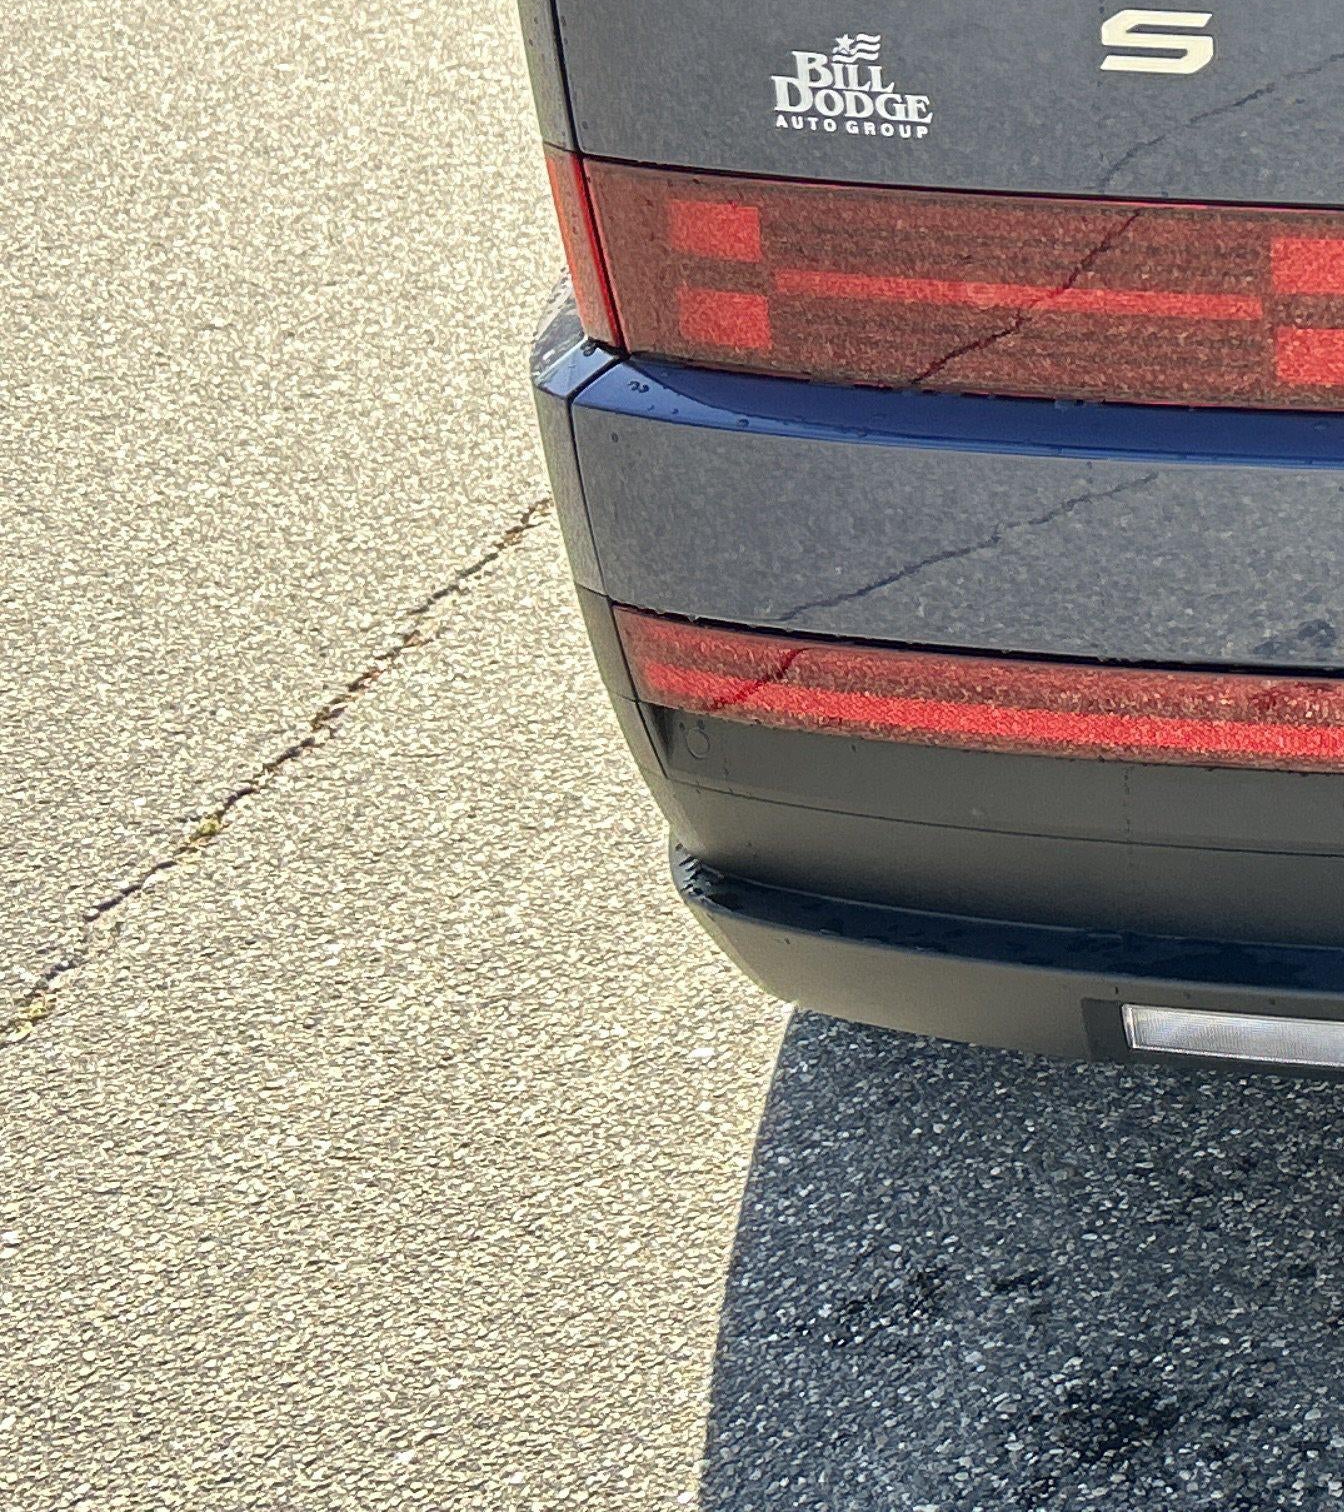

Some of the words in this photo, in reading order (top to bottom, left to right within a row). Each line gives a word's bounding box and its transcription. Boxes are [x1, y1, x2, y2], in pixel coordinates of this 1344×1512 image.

[792, 51, 894, 93] BILL
[771, 76, 933, 124] DODGE
[776, 114, 837, 132] AUTO
[845, 120, 929, 138] GROUP
